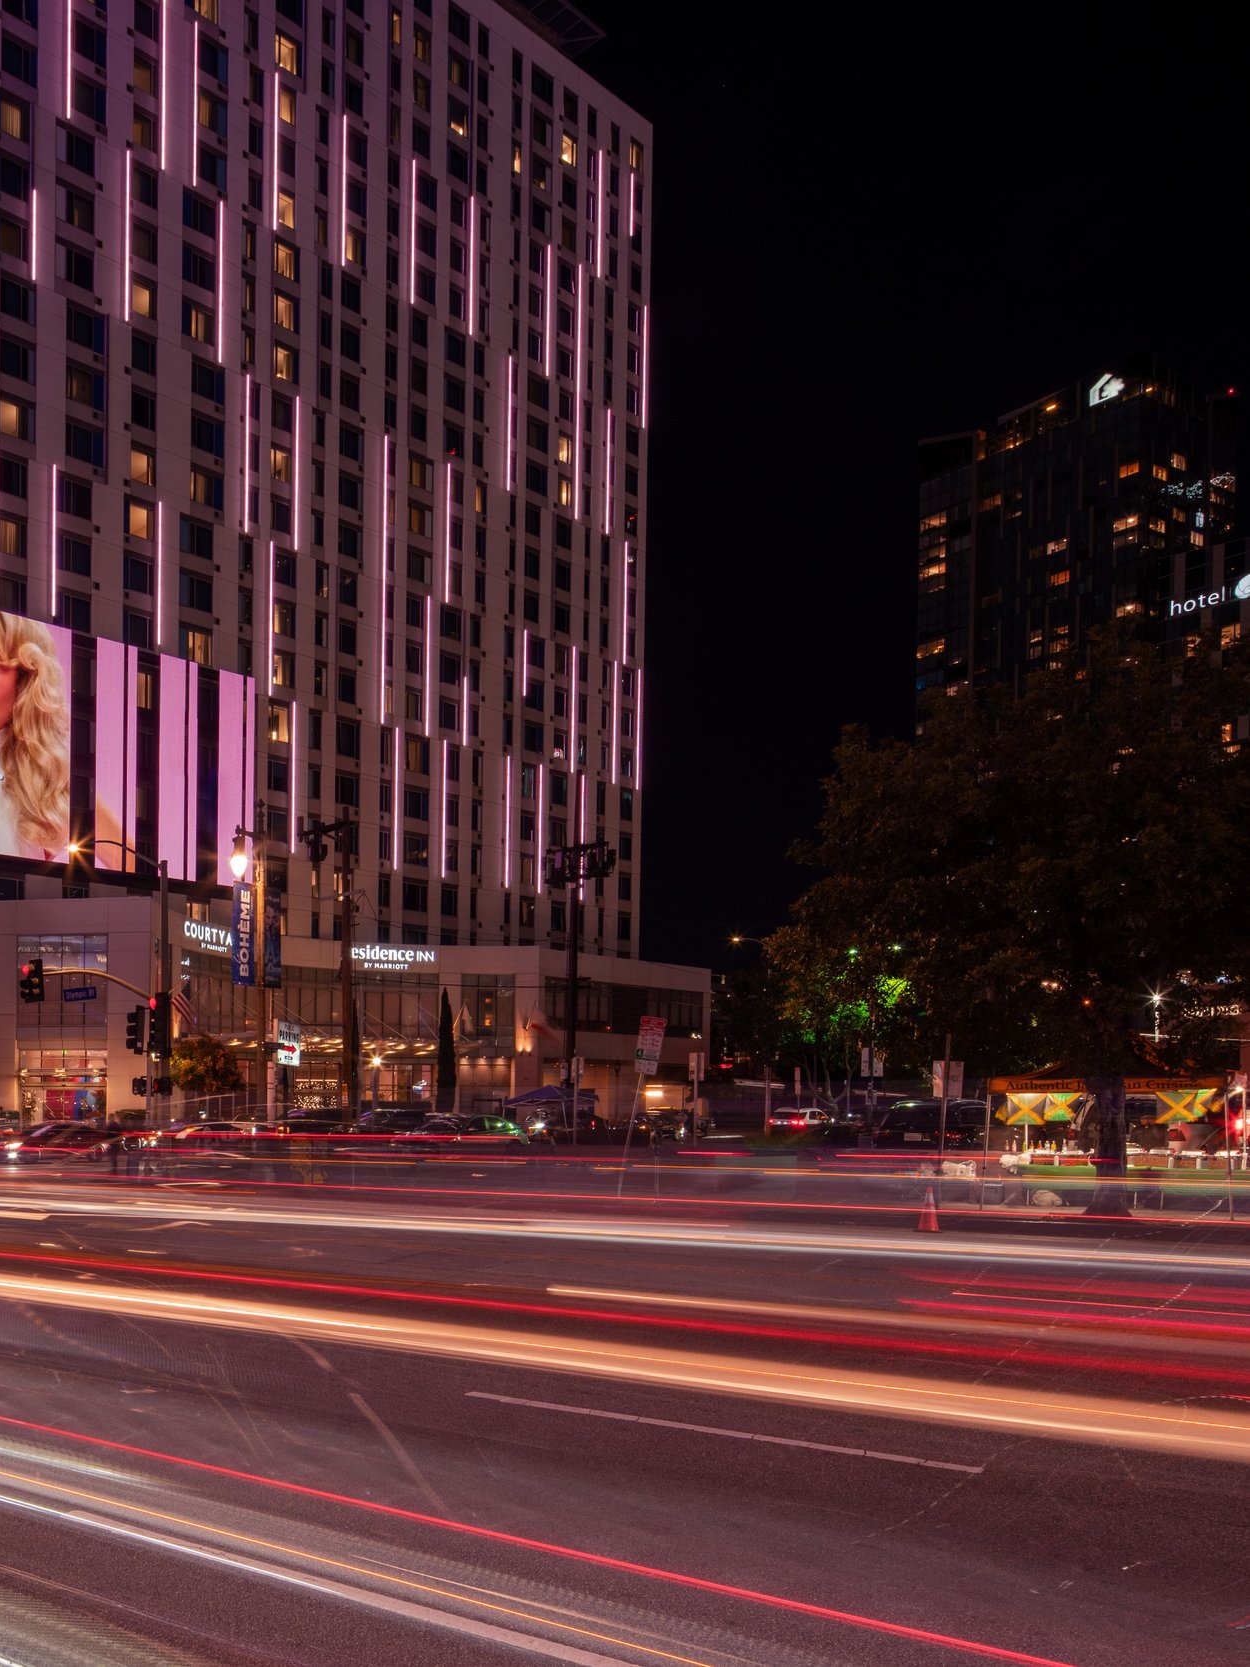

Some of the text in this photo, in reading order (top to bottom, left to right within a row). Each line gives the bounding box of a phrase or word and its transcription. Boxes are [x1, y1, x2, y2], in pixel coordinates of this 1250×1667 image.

[1170, 586, 1225, 616] hotel
[184, 920, 233, 946] COURTYA
[237, 889, 251, 977] BOHÈME
[207, 943, 227, 953] MARRIOTT
[351, 945, 435, 962] esidence INN
[279, 1029, 299, 1044] PARKING
[1006, 1080, 1072, 1092] Authentic
